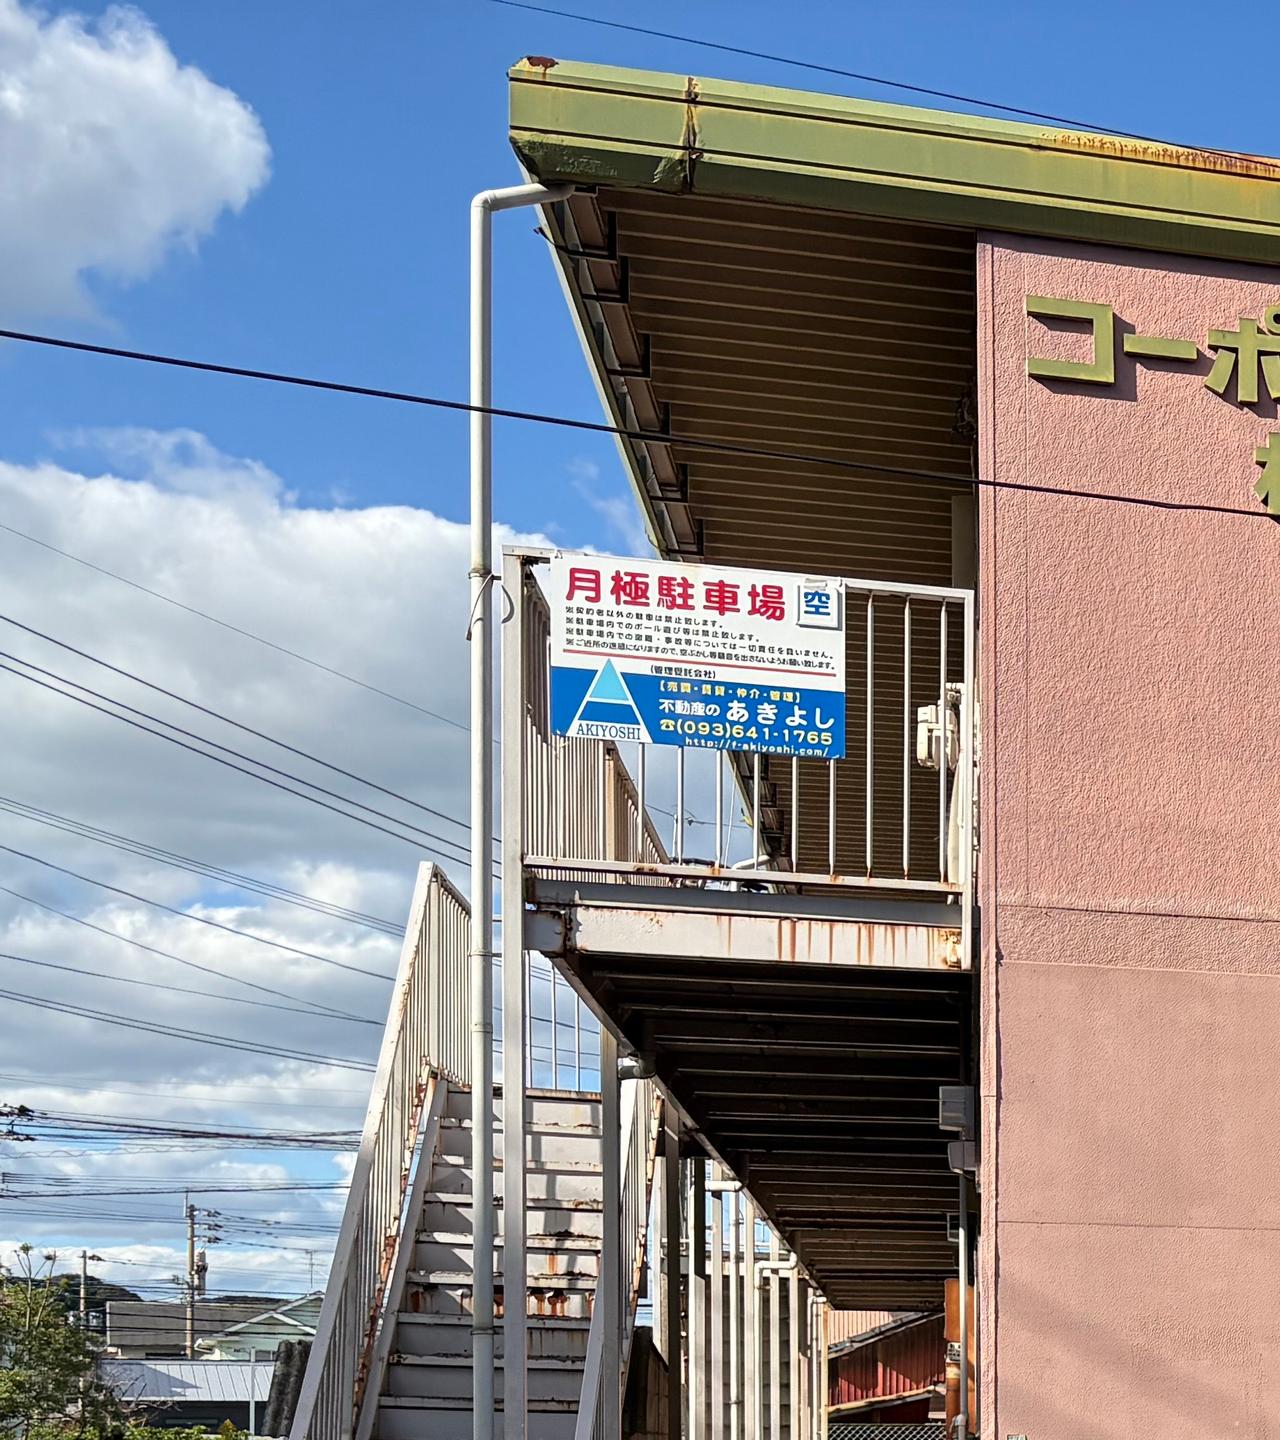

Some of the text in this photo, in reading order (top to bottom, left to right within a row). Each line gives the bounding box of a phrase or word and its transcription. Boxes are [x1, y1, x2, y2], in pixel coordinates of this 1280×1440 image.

[565, 567, 786, 622] 月極駐車場
[803, 590, 832, 617] 空
[576, 722, 641, 740] AKIYOSHI
[676, 718, 833, 745] (093)641-1765
